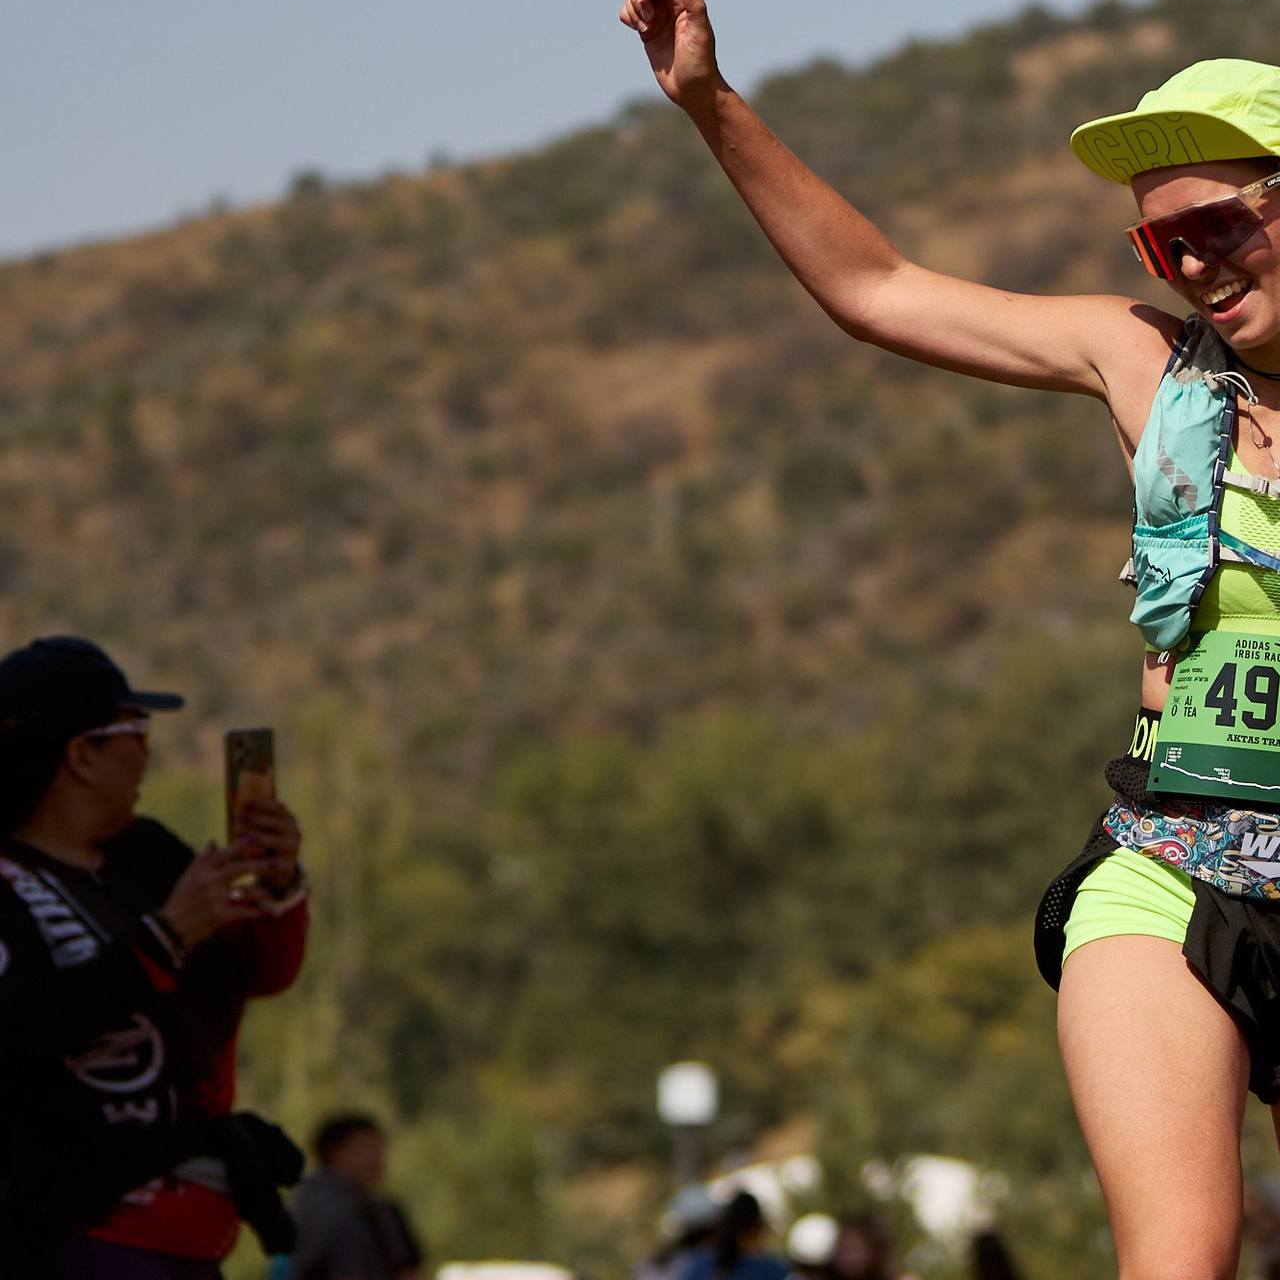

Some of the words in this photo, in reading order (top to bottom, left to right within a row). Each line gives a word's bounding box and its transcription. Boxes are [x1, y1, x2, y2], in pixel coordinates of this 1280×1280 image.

[1235, 639, 1270, 651] ADIDAS
[1234, 649, 1261, 661] IRBIS
[1183, 706, 1197, 718] TEA
[1226, 734, 1260, 745] AKTAS
